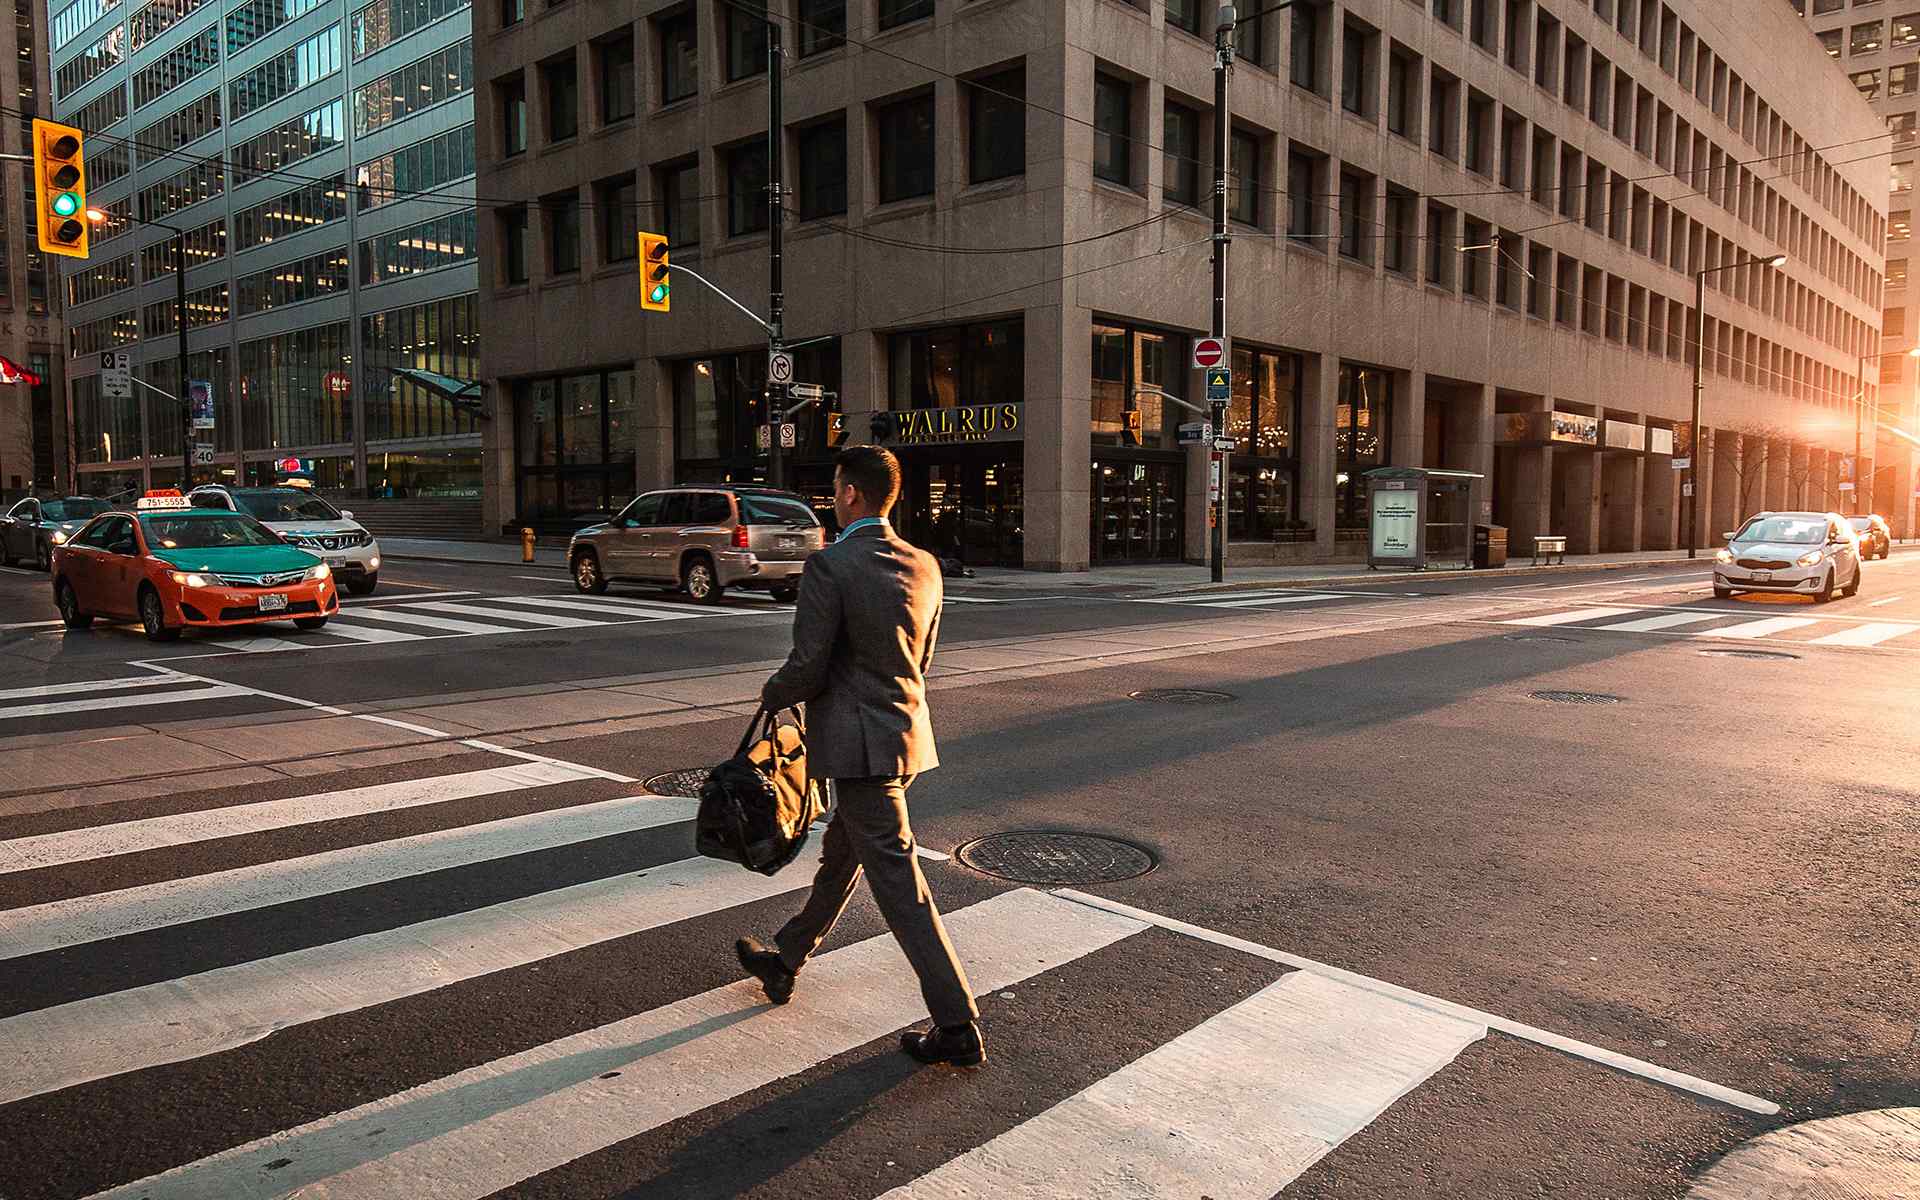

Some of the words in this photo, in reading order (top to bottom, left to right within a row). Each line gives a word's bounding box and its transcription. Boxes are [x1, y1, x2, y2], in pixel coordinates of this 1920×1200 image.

[896, 404, 1018, 436] WALRUS
[198, 451, 214, 462] 40
[146, 498, 185, 507] 751-5555
